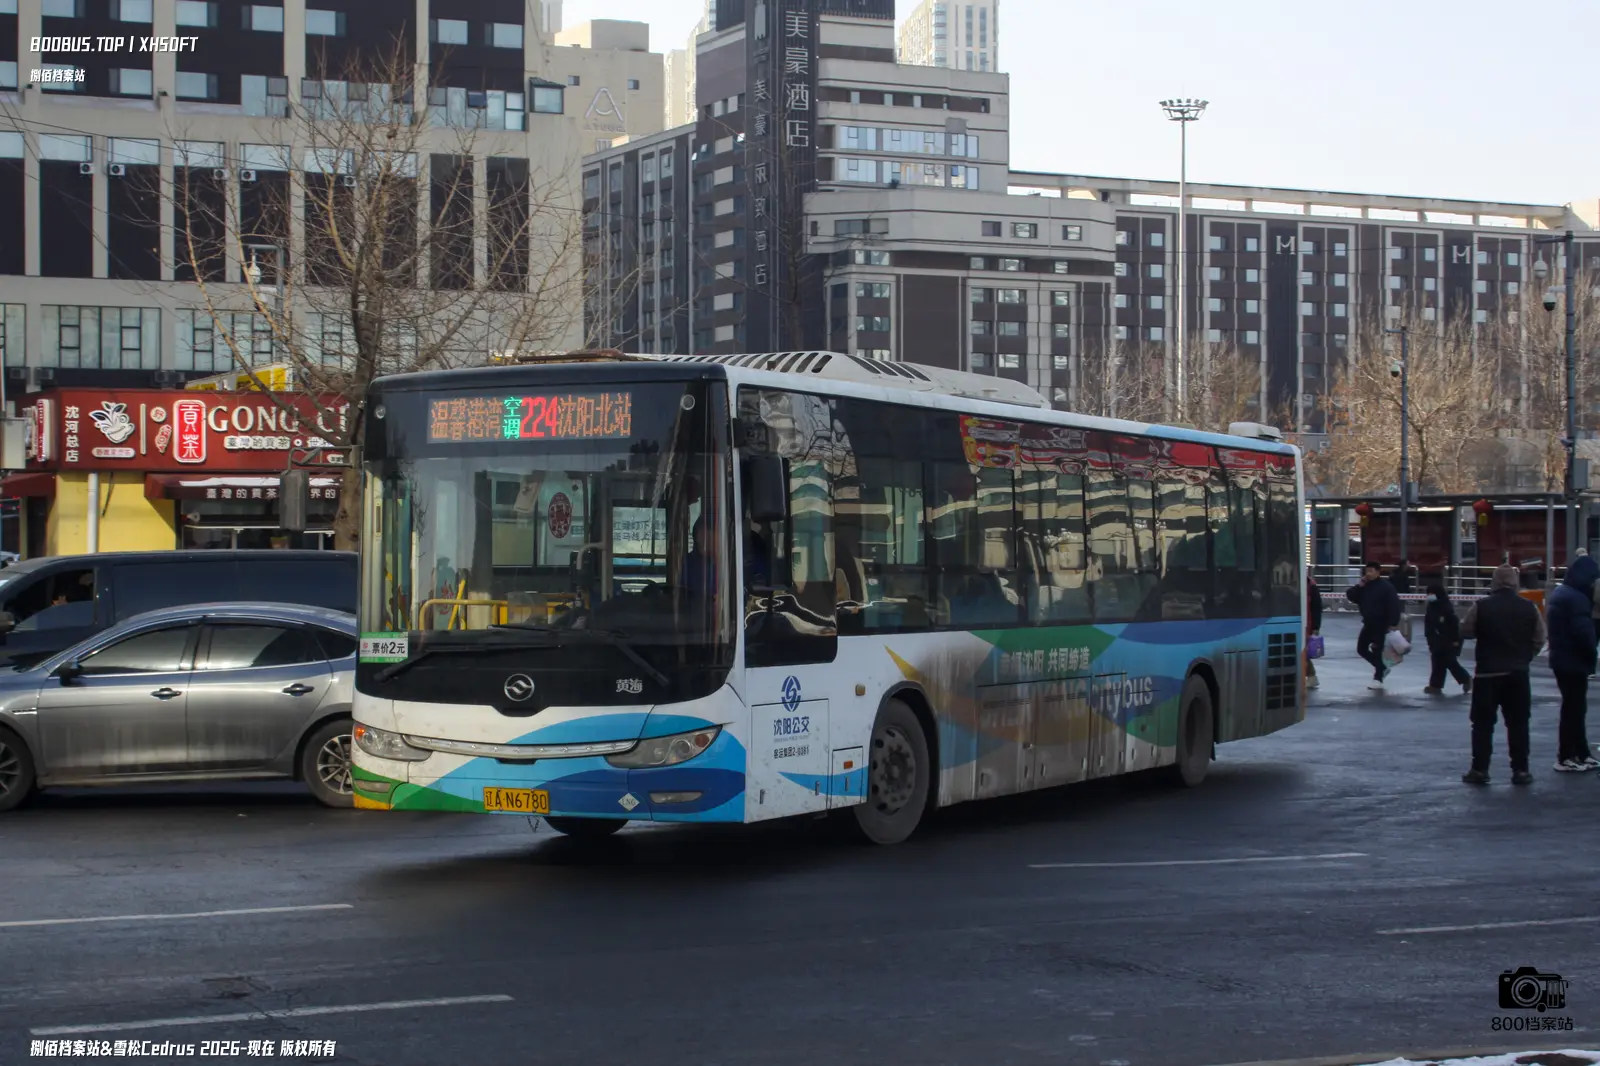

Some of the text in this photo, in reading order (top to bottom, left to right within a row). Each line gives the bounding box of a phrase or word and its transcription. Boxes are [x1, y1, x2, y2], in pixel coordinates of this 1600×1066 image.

[785, 9, 809, 148] 美豪酒店
[65, 406, 80, 462] 沈河总店
[208, 405, 299, 432] GONG
[502, 397, 522, 440] 空调
[520, 396, 558, 438] 224
[557, 393, 632, 437] 沈阳北站
[372, 641, 406, 655] 票价2元
[616, 678, 643, 693] 黄海
[774, 716, 810, 736] 沈阳公交
